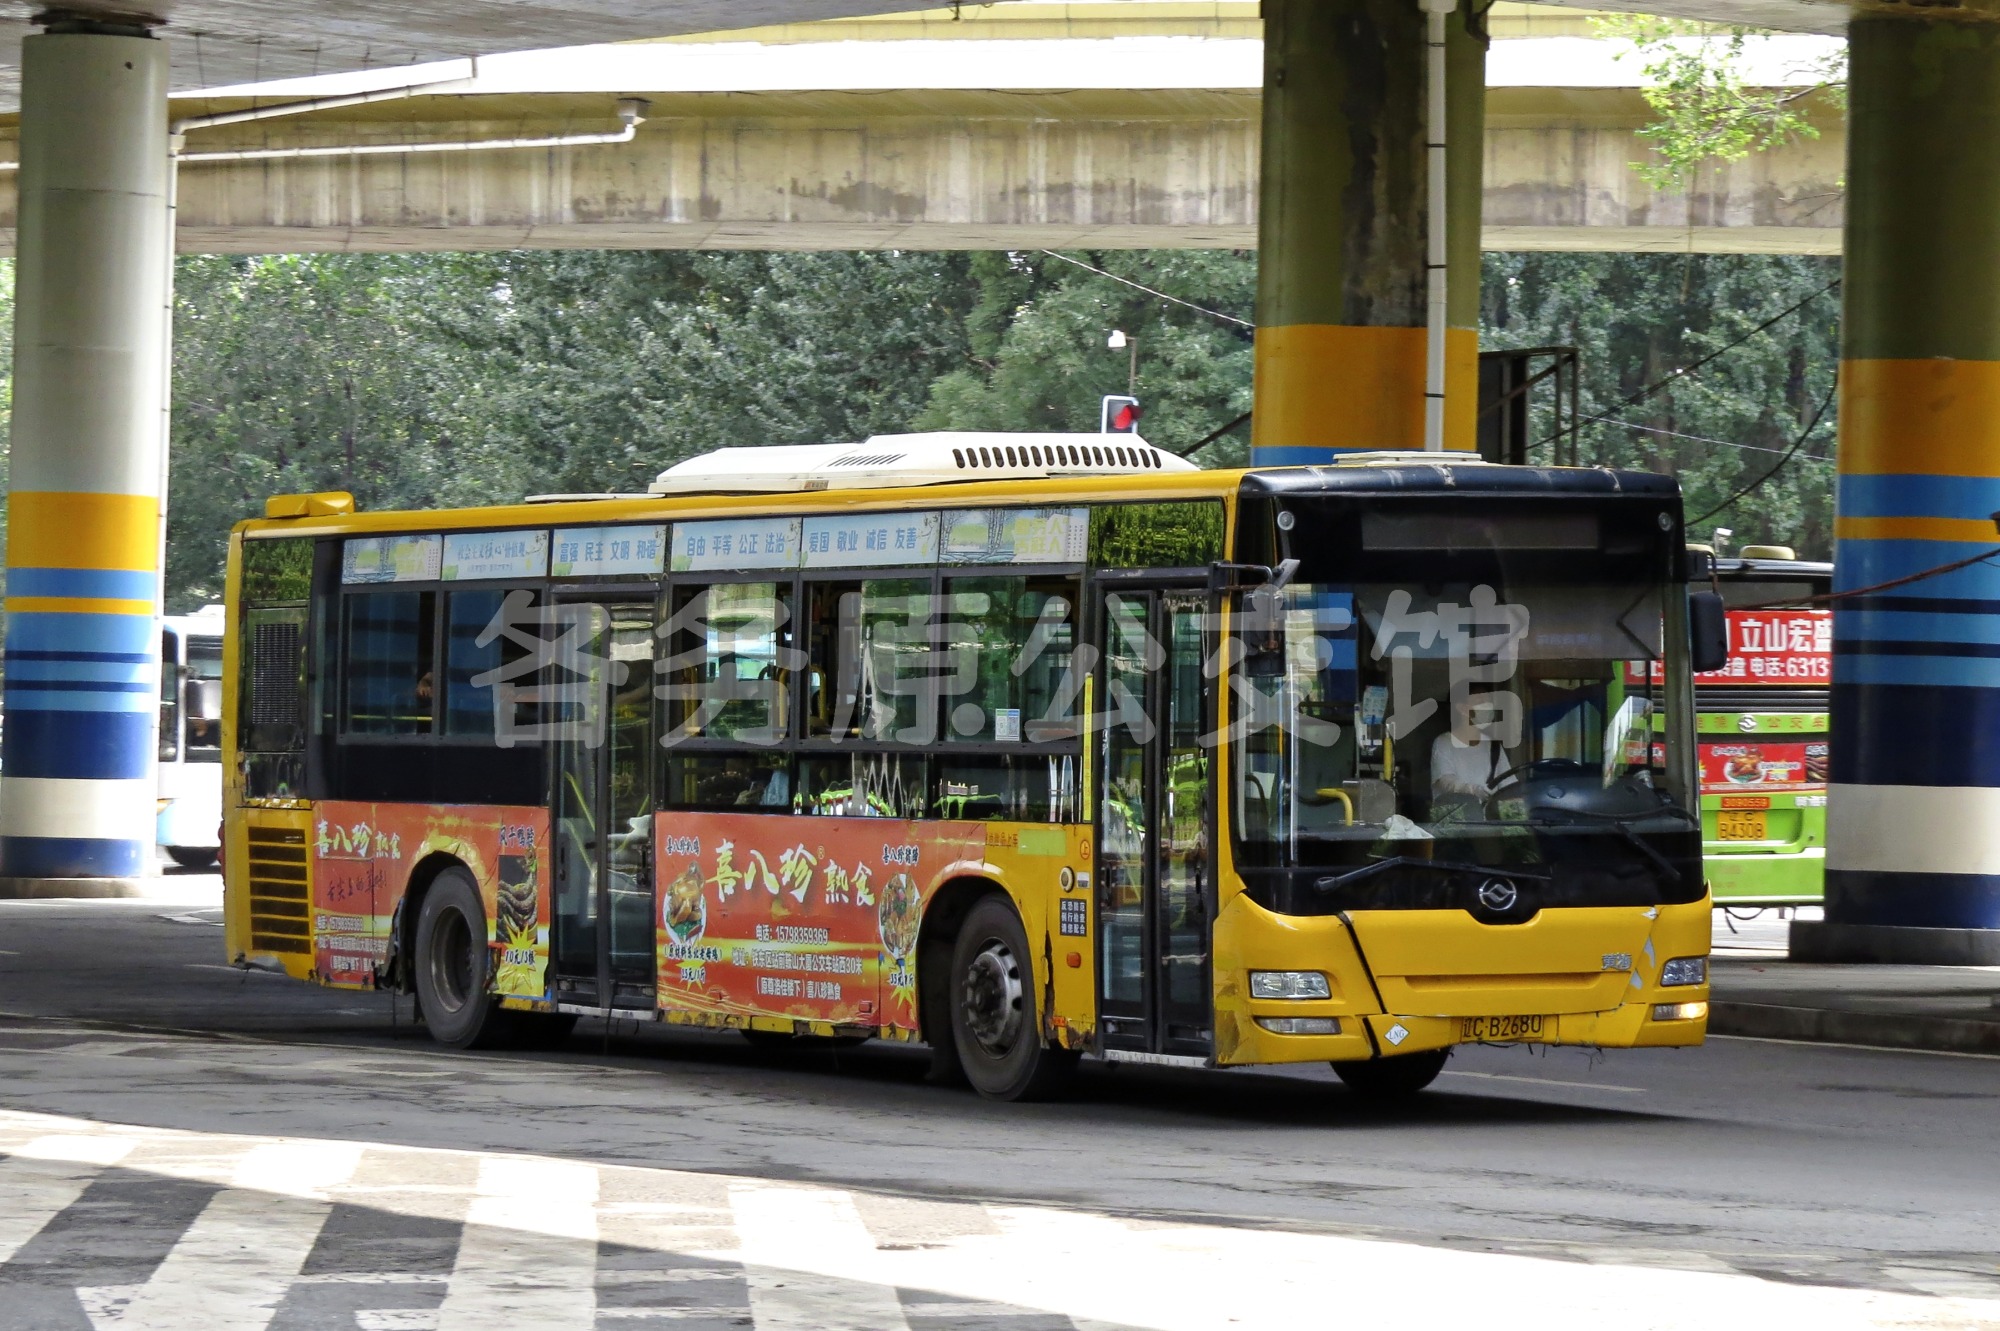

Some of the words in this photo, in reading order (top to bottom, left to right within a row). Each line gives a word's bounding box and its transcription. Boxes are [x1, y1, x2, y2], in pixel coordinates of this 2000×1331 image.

[560, 543, 579, 562] 富强
[584, 542, 603, 562] 民主
[610, 540, 630, 561] 文明
[637, 539, 656, 560] 和谐
[686, 536, 706, 557] 自由
[712, 535, 732, 556] 平等
[739, 533, 759, 555] 公正
[765, 532, 785, 553] 法治
[809, 531, 830, 553] 爱国
[837, 530, 858, 552] 敬业
[866, 528, 888, 551] 诚信
[895, 527, 917, 549] 友善
[1739, 618, 1832, 653] 立山宏盛
[313, 818, 372, 858] 喜八珍
[1720, 823, 1763, 839] B4308
[706, 838, 818, 904] 喜八珍
[823, 858, 876, 907] 熟食
[1061, 901, 1085, 911] 反恐防范
[1601, 952, 1631, 970] 黄海
[1389, 1029, 1405, 1040] LNG
